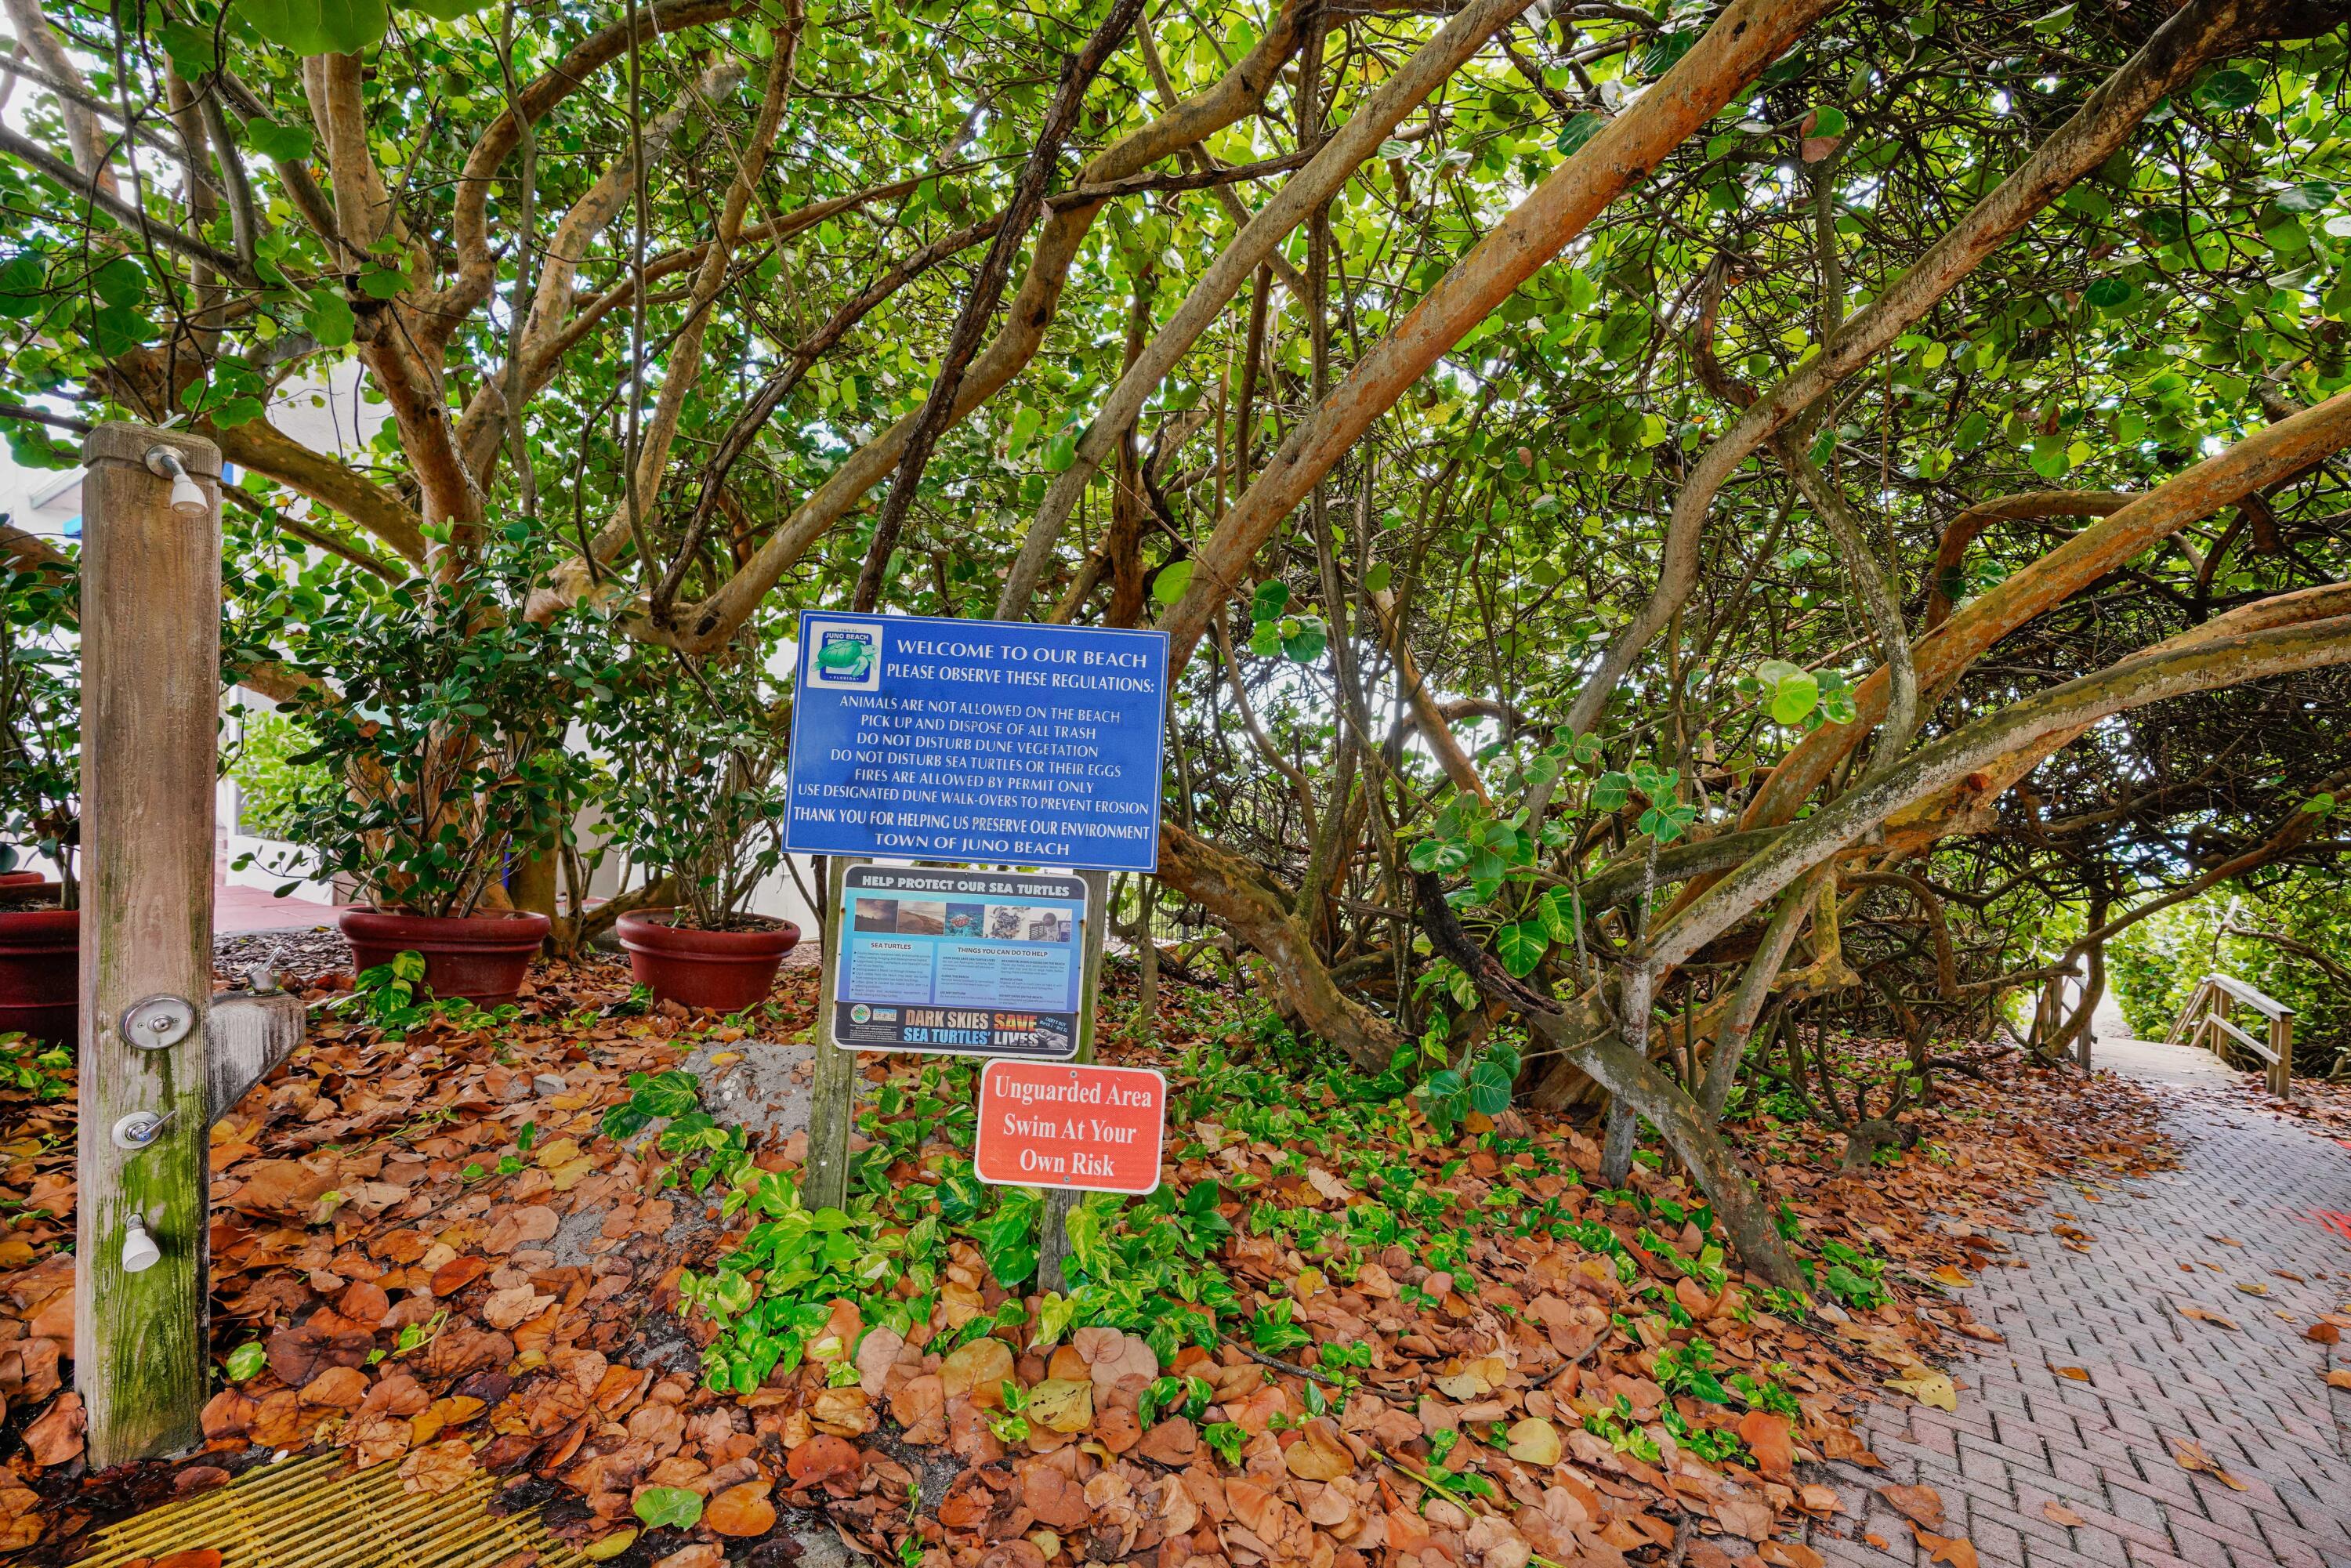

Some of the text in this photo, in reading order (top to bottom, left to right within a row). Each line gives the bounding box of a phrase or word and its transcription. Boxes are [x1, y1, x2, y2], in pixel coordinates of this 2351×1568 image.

[897, 639, 1146, 668] WELCOME TO OUR BEACH
[886, 663, 1154, 692] PLEASE OBSERVE THESE REGULATIONS:
[839, 695, 1119, 722] ANIMALS ARE NOT ALLOWED ON THE BEACH
[861, 714, 1096, 739] PICK UP AND DISPOSE OF ALL TRASH
[857, 732, 1098, 757] DO NOT DISTURB DUNE VEGETATION
[831, 748, 1121, 777] DO NOT DISTURB SEA TURTLES OR THEIR EGGS
[855, 768, 1093, 793] FIRES ARE ALLOWED BY PERMIT ONLY
[798, 783, 1148, 814] USE DESIGNATED DUNE WALK-OVERS TO PREVENT EROSION
[794, 806, 1150, 839] THANK YOU FOR HELPING US PRESERVE OUR ENVIRONMENT
[875, 833, 1069, 855] TOWN OF JUNO BEACH
[862, 875, 1070, 896] HELP PROTECT OUR SEA TURTLES
[905, 1009, 944, 1028] DARK
[947, 1012, 989, 1030] SKIES
[994, 1013, 1038, 1032] SAVE
[904, 1027, 928, 1043] SEA
[994, 1031, 1039, 1047] LIVES
[994, 1074, 1151, 1107] Unguarded Area
[1003, 1113, 1136, 1143] Swim At Your
[1020, 1149, 1114, 1176] Own Risk
